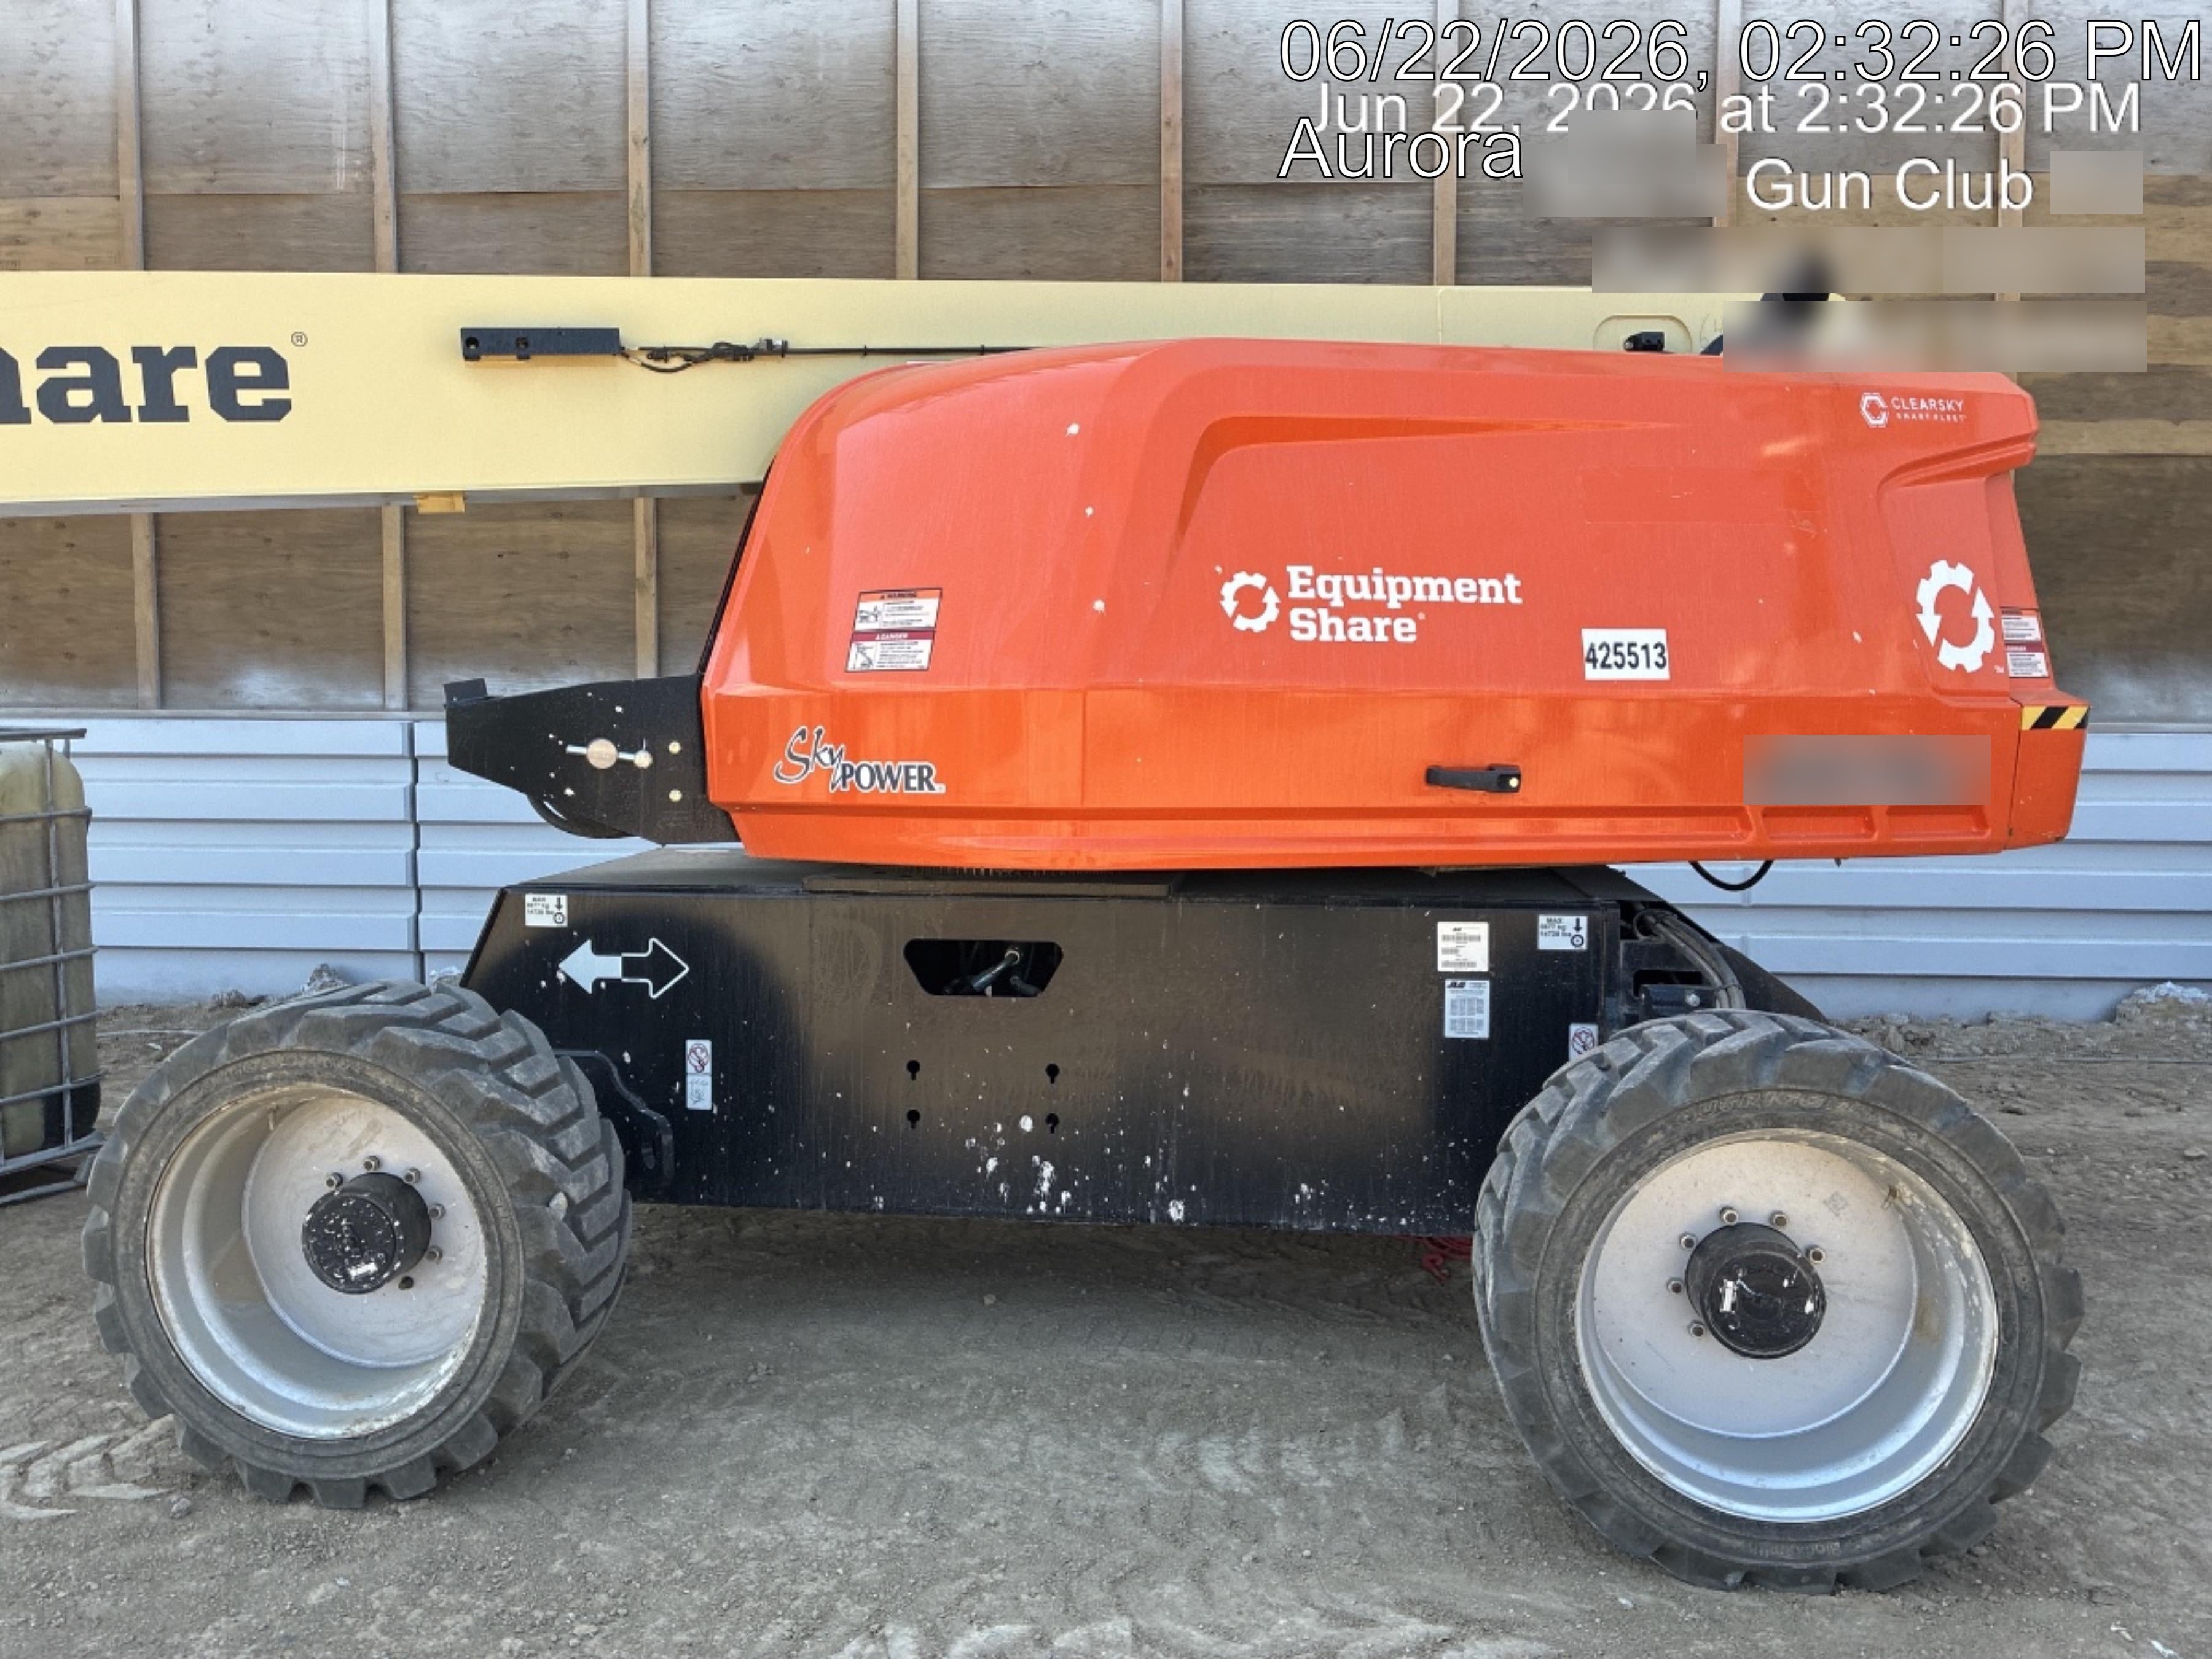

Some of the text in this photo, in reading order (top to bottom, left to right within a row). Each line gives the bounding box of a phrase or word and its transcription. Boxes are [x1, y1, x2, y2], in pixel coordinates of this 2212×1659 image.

[1891, 396, 1964, 412] CLEARSKY
[1287, 565, 1523, 609] Equipment
[1290, 608, 1417, 643] Share
[1585, 642, 1667, 670] 425513
